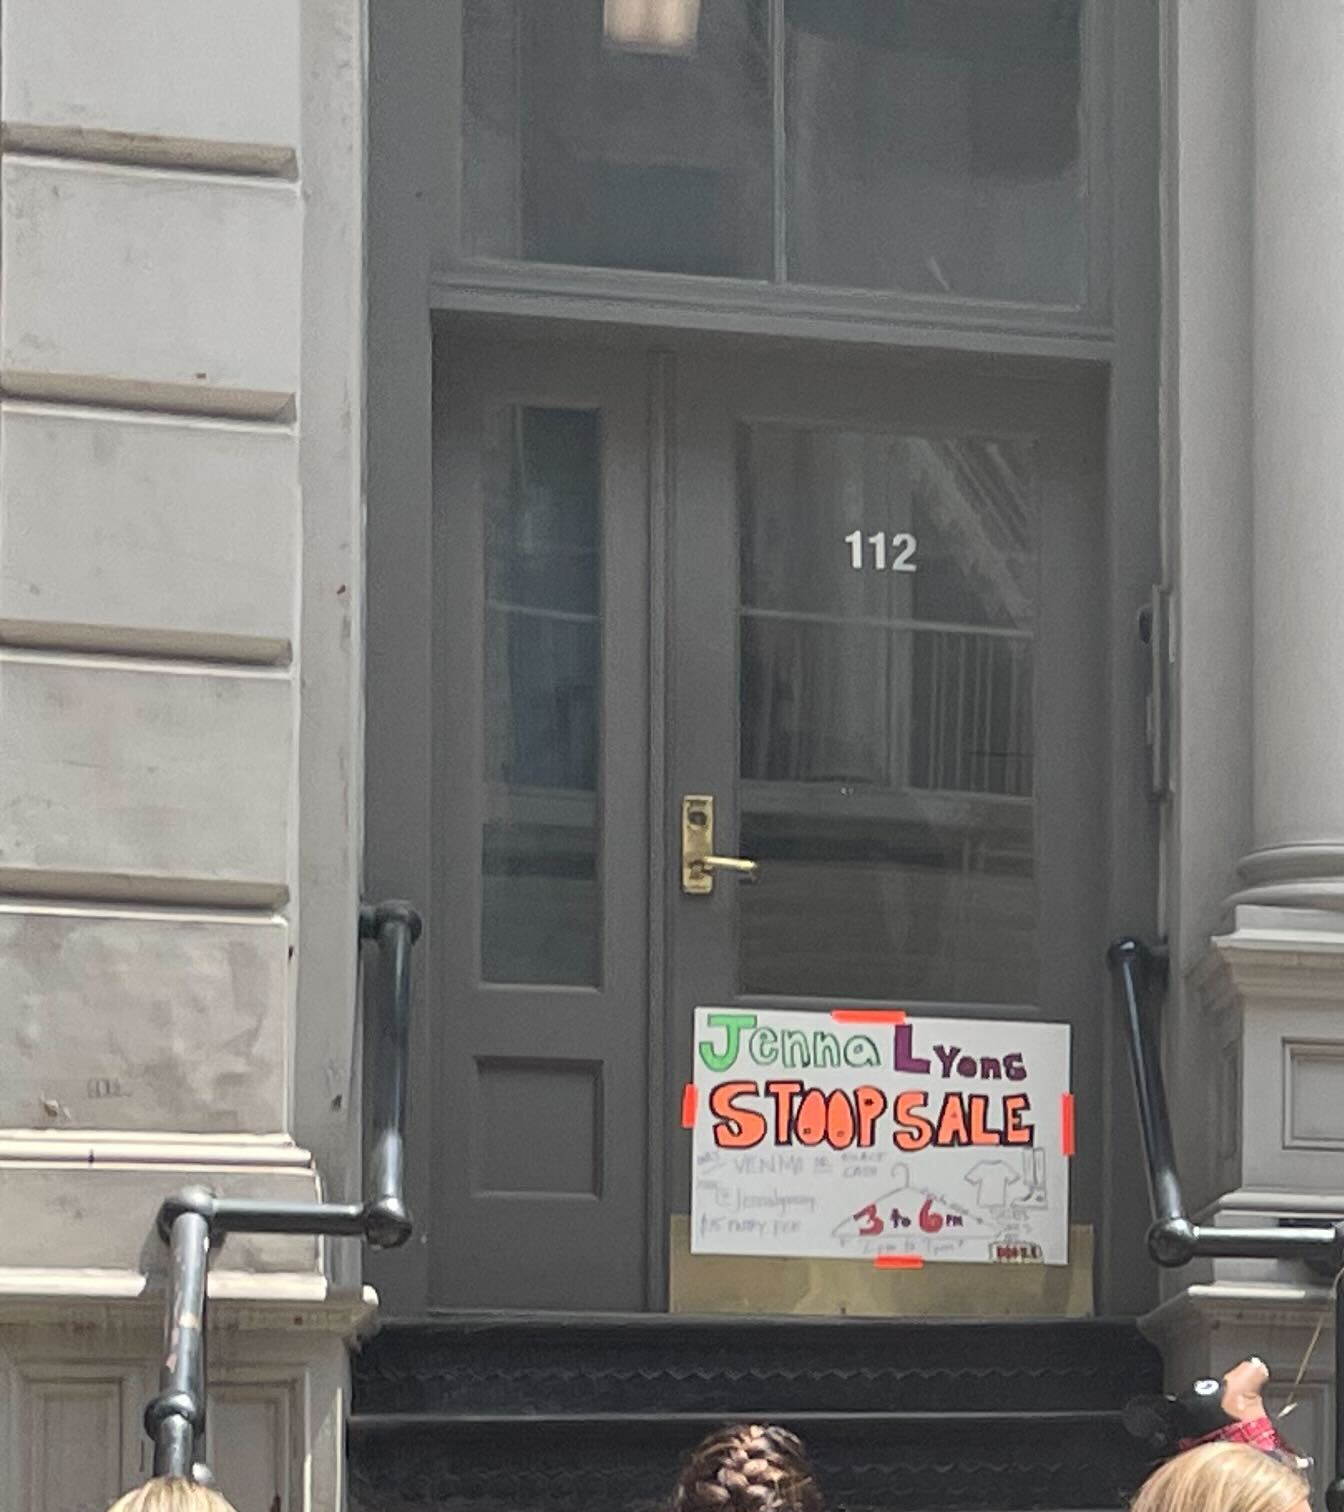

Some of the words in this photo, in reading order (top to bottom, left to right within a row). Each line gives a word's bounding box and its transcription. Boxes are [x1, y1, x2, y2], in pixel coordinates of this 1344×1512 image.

[844, 530, 917, 572] 112
[699, 1013, 881, 1073] Jenna
[709, 1080, 887, 1151] STOOP
[893, 1089, 1035, 1152] SALE
[853, 1203, 884, 1236] 3
[891, 1208, 911, 1228] to
